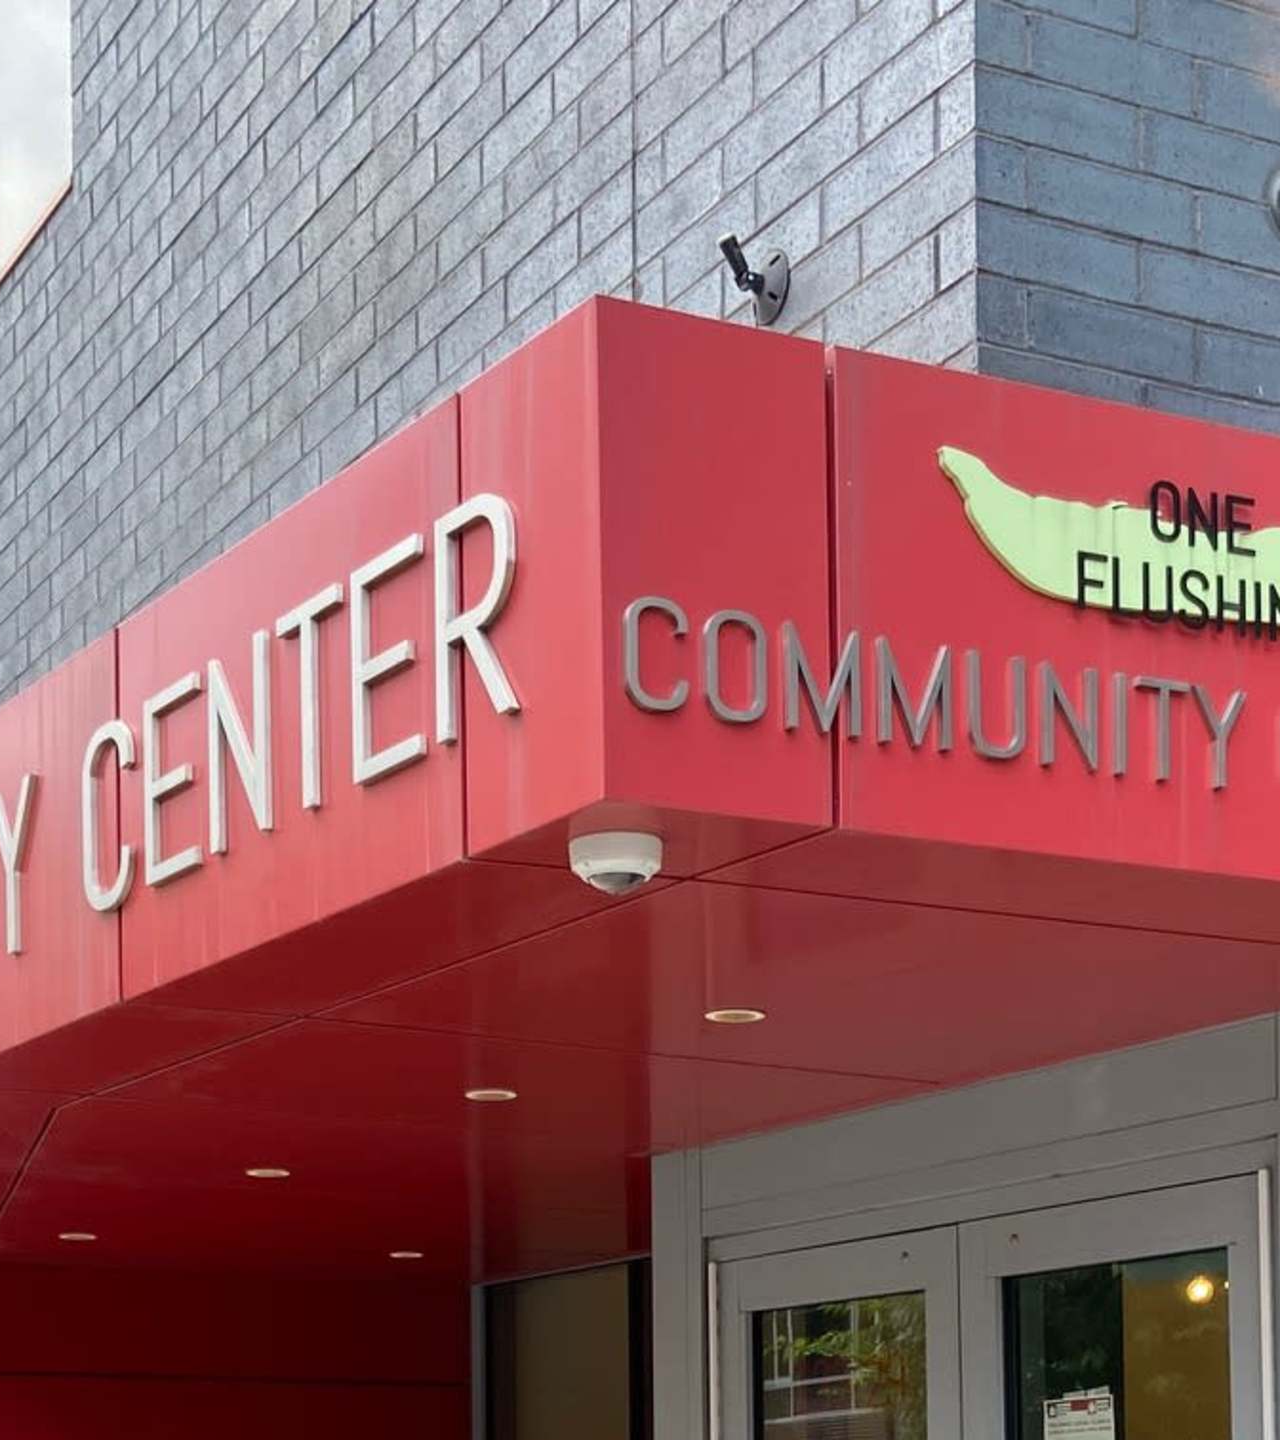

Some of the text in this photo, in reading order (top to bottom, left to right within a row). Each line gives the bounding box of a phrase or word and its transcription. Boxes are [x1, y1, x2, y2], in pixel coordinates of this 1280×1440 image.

[1149, 480, 1256, 557] ONE
[82, 493, 522, 912] CENTER
[625, 597, 1246, 791] COMMUNITY
